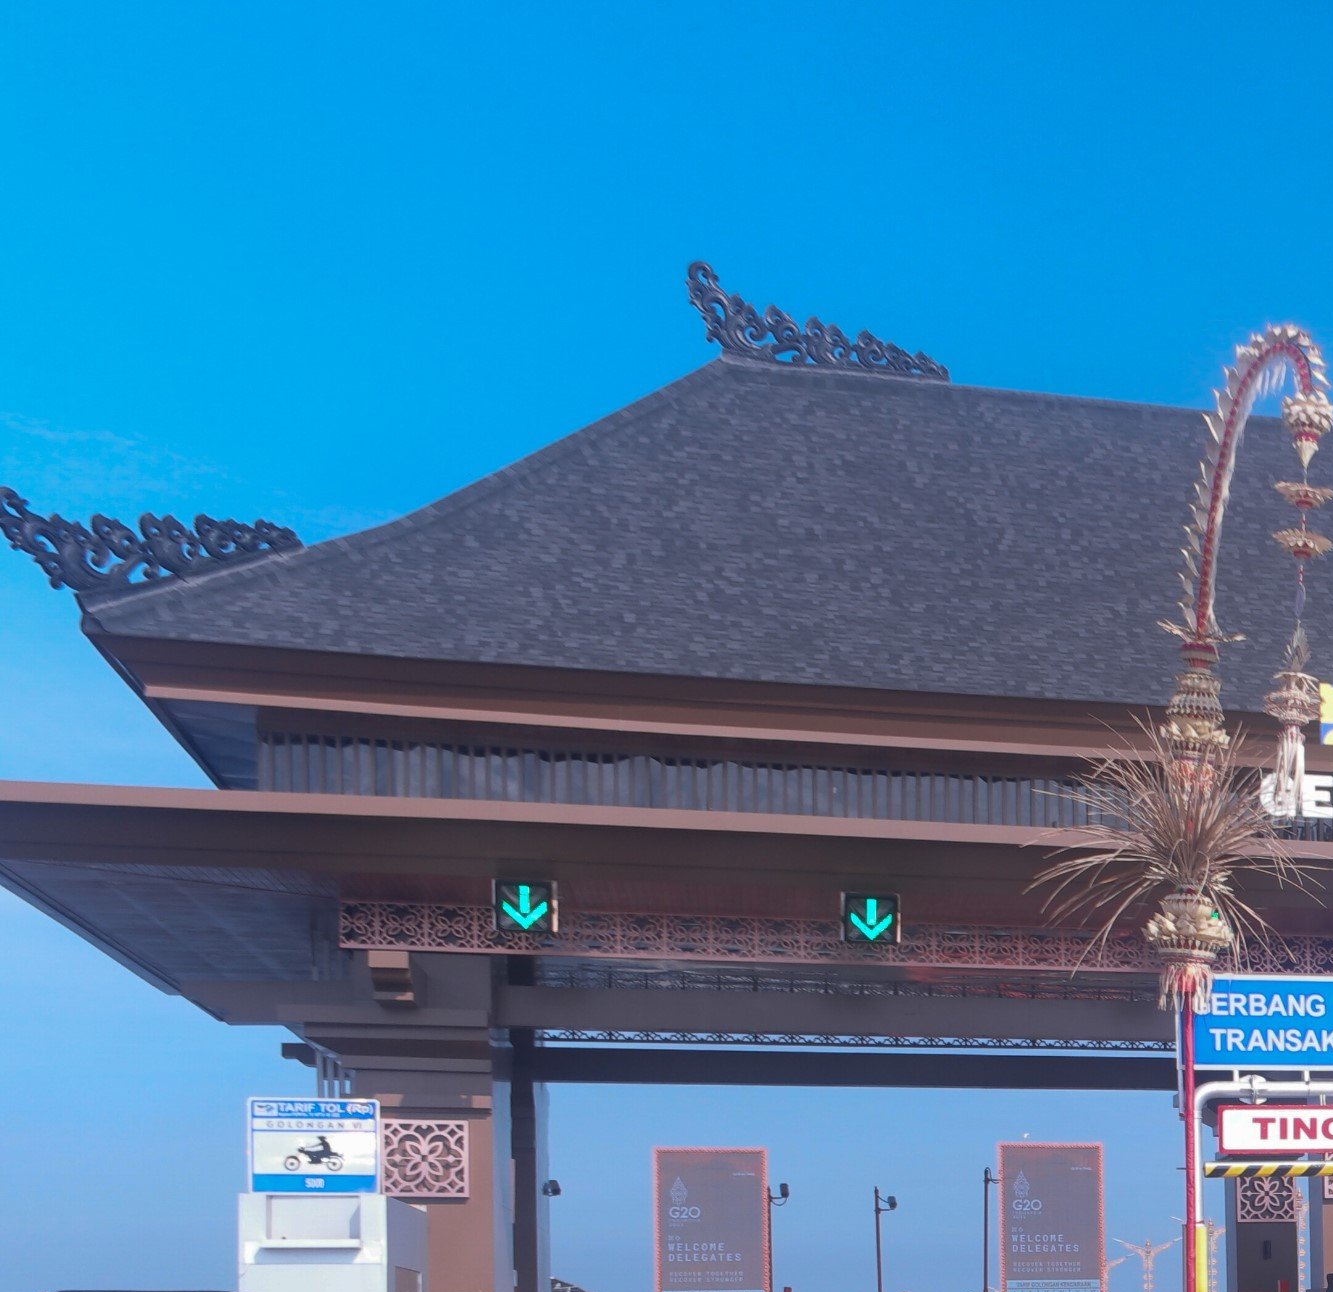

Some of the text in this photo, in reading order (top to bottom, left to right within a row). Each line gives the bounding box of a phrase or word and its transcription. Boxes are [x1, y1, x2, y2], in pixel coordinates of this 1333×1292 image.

[280, 1103, 374, 1115] TARIF TOL (Rp)
[1012, 1199, 1042, 1211] G20
[669, 1206, 700, 1218] G20
[1011, 1234, 1064, 1242] WELCOME
[668, 1243, 725, 1251] WELCOME
[1012, 1244, 1080, 1253] DELEGATES
[668, 1253, 742, 1261] DELEGATES
